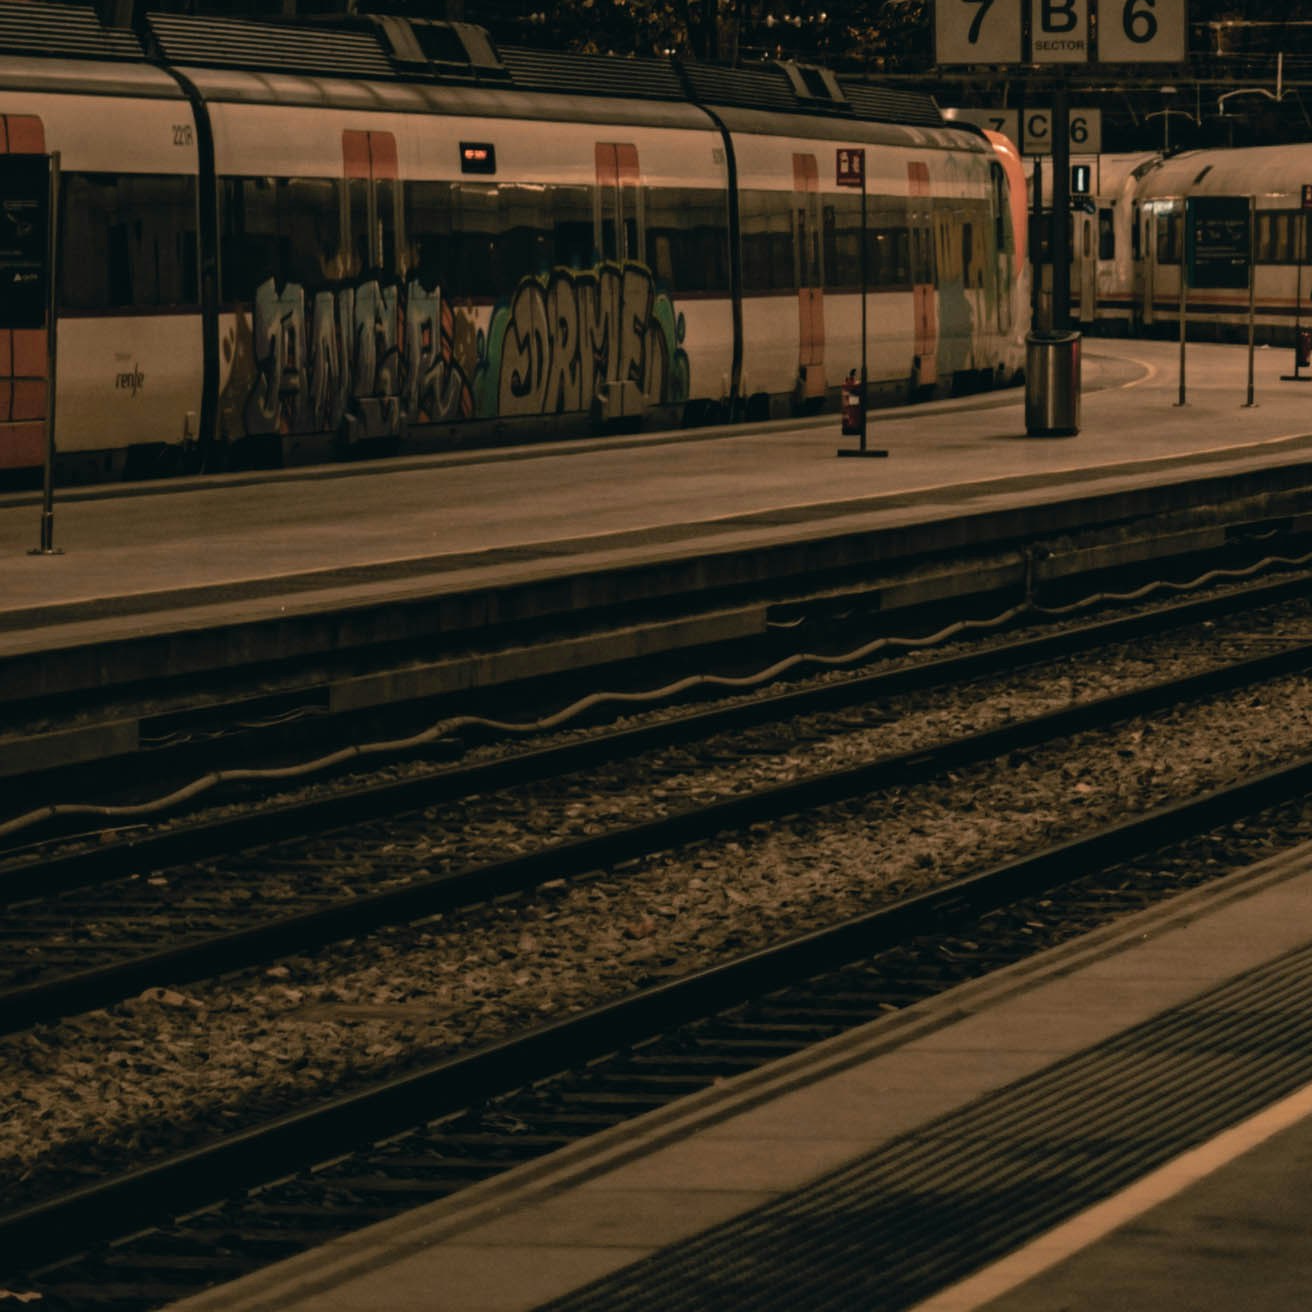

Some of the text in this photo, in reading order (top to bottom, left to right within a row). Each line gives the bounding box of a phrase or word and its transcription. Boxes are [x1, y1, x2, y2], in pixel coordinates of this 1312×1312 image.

[1035, 40, 1085, 51] SECTOR
[1028, 114, 1048, 138] C
[1070, 117, 1088, 143] 6
